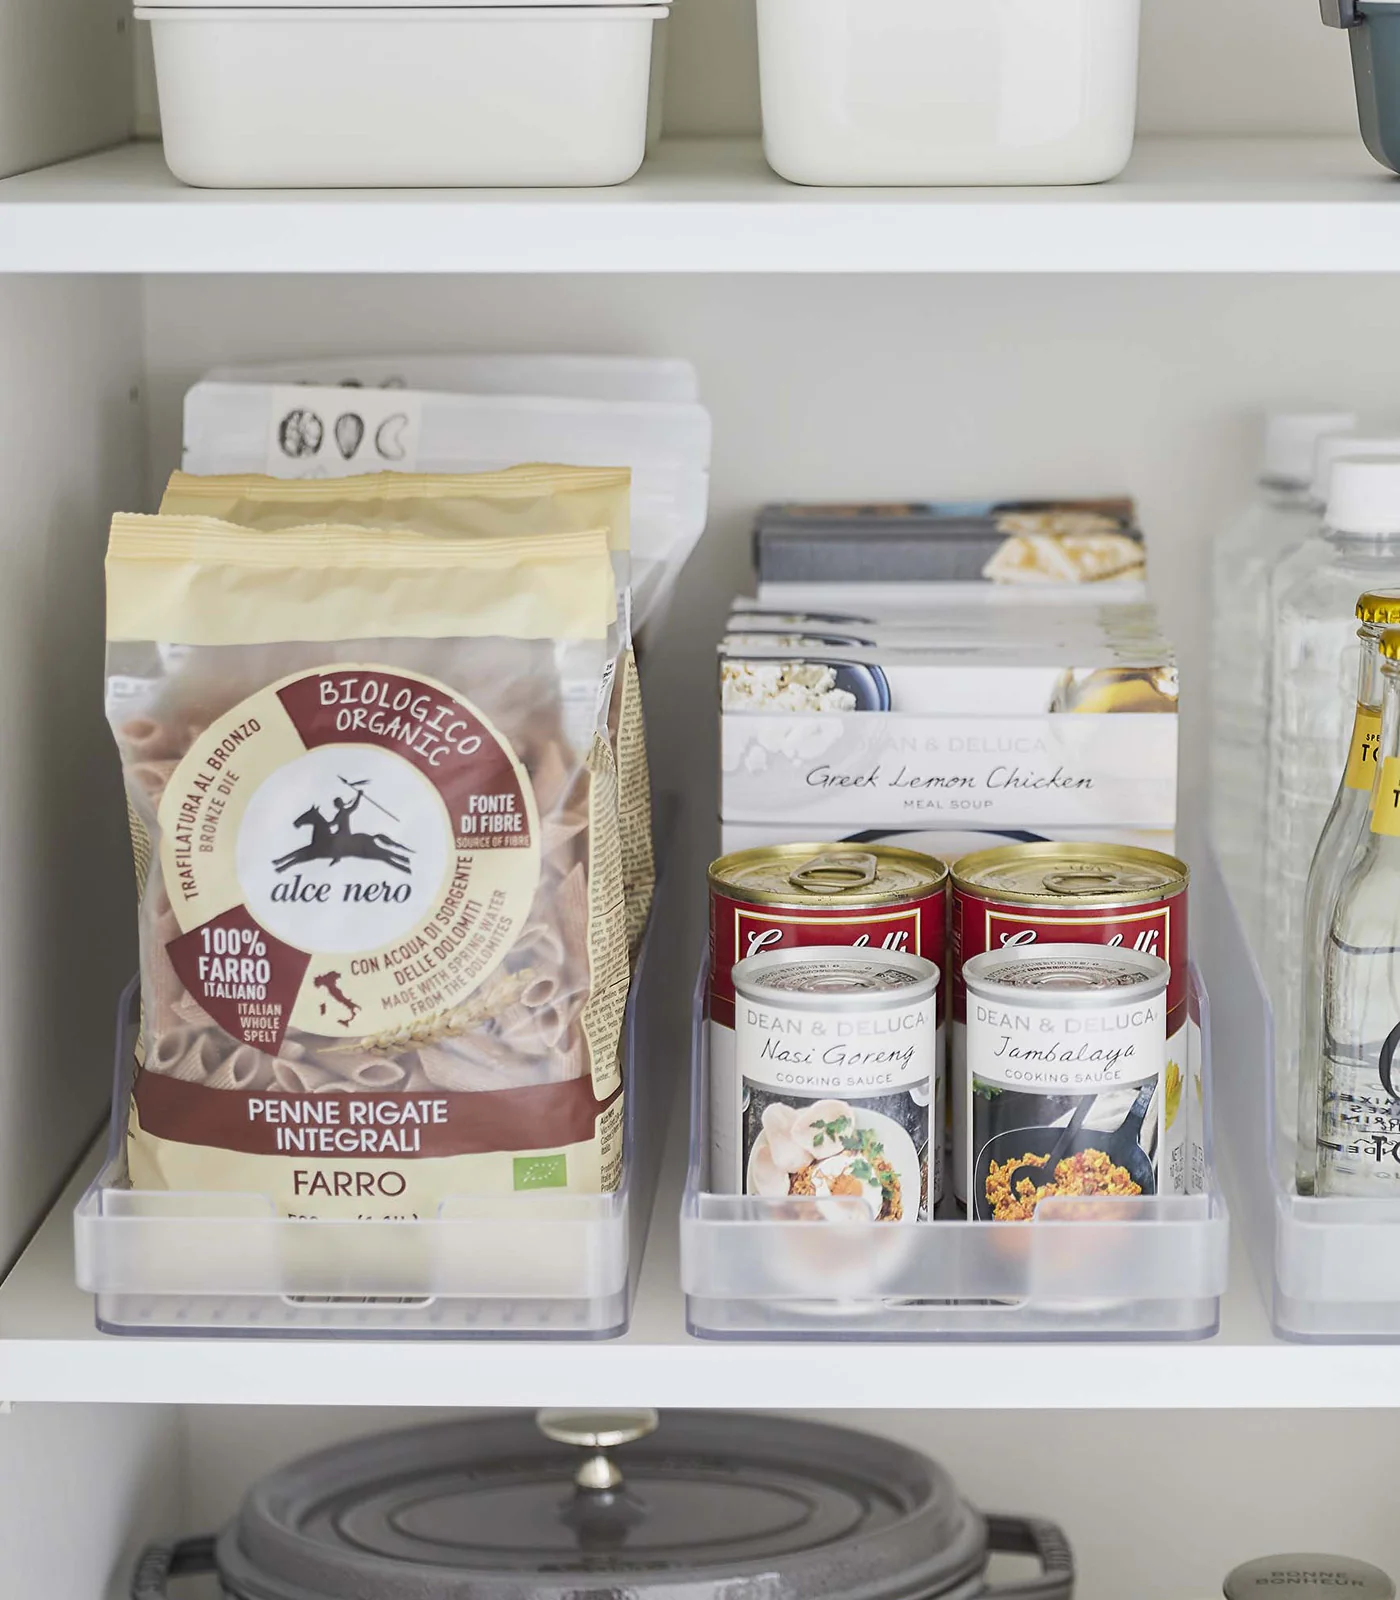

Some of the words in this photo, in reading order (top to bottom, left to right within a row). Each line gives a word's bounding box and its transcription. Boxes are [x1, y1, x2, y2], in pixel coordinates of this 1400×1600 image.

[319, 678, 482, 755] BIOLOGICO
[336, 708, 450, 766] ORGANIC
[956, 737, 1048, 752] DELUCA
[806, 765, 880, 789] Greek
[889, 766, 977, 789] Lemon
[986, 765, 1096, 789] Chicken
[175, 793, 202, 901] TRAFILATURA
[193, 773, 216, 793] AL
[206, 718, 262, 771] BRONZO
[199, 797, 226, 853] BRONZE
[217, 770, 240, 796] DIE
[469, 794, 516, 813] FONTE
[904, 800, 944, 810] MEAL
[950, 800, 994, 810] SOUP
[461, 815, 477, 834] DI
[480, 813, 523, 833] FIBRE
[456, 837, 490, 849] SOURCE
[492, 837, 502, 848] OF
[504, 836, 530, 847] FIBRE
[270, 874, 332, 903] alce
[343, 880, 412, 904] nero
[350, 956, 381, 976] CON
[384, 935, 429, 969] ACQUA
[423, 922, 443, 940] DI
[435, 855, 473, 925] SORGENTE
[200, 928, 266, 956] 100%
[381, 989, 418, 1010] MADE
[418, 970, 451, 995] WITH
[447, 932, 486, 974] SPRING
[479, 889, 507, 933] WATER
[393, 953, 437, 986] DELLE
[433, 899, 483, 960] DOLOMITI
[199, 956, 271, 984] FARRO
[409, 993, 444, 1017] FROM
[443, 975, 468, 996] THE
[464, 915, 513, 978] DOLOMITES
[204, 982, 266, 1000] ITALIANO
[238, 1003, 282, 1016] ITALIAN
[240, 1017, 279, 1029] WHOLE
[977, 1006, 1030, 1031] DEAN
[1039, 1018, 1055, 1033] &
[1065, 1008, 1155, 1034] DELUCA
[244, 1031, 277, 1043] SPELT
[747, 1010, 803, 1034] DEAN
[811, 1021, 827, 1037] &
[837, 1012, 926, 1037] DELUCA
[761, 1038, 815, 1063] Nasi
[822, 1044, 916, 1070] Goreng
[993, 1036, 1136, 1072] Jambalaya
[776, 1072, 841, 1087] COOKING
[847, 1073, 892, 1086] SAUCE
[1005, 1069, 1069, 1083] COOKING
[1075, 1069, 1121, 1083] SAUCE
[248, 1098, 341, 1125] PENNE
[349, 1099, 448, 1125] RIGATE
[277, 1128, 420, 1152] INTEGRALI
[293, 1170, 407, 1197] FARRO
[1255, 1578, 1365, 1587] BONHEUR
